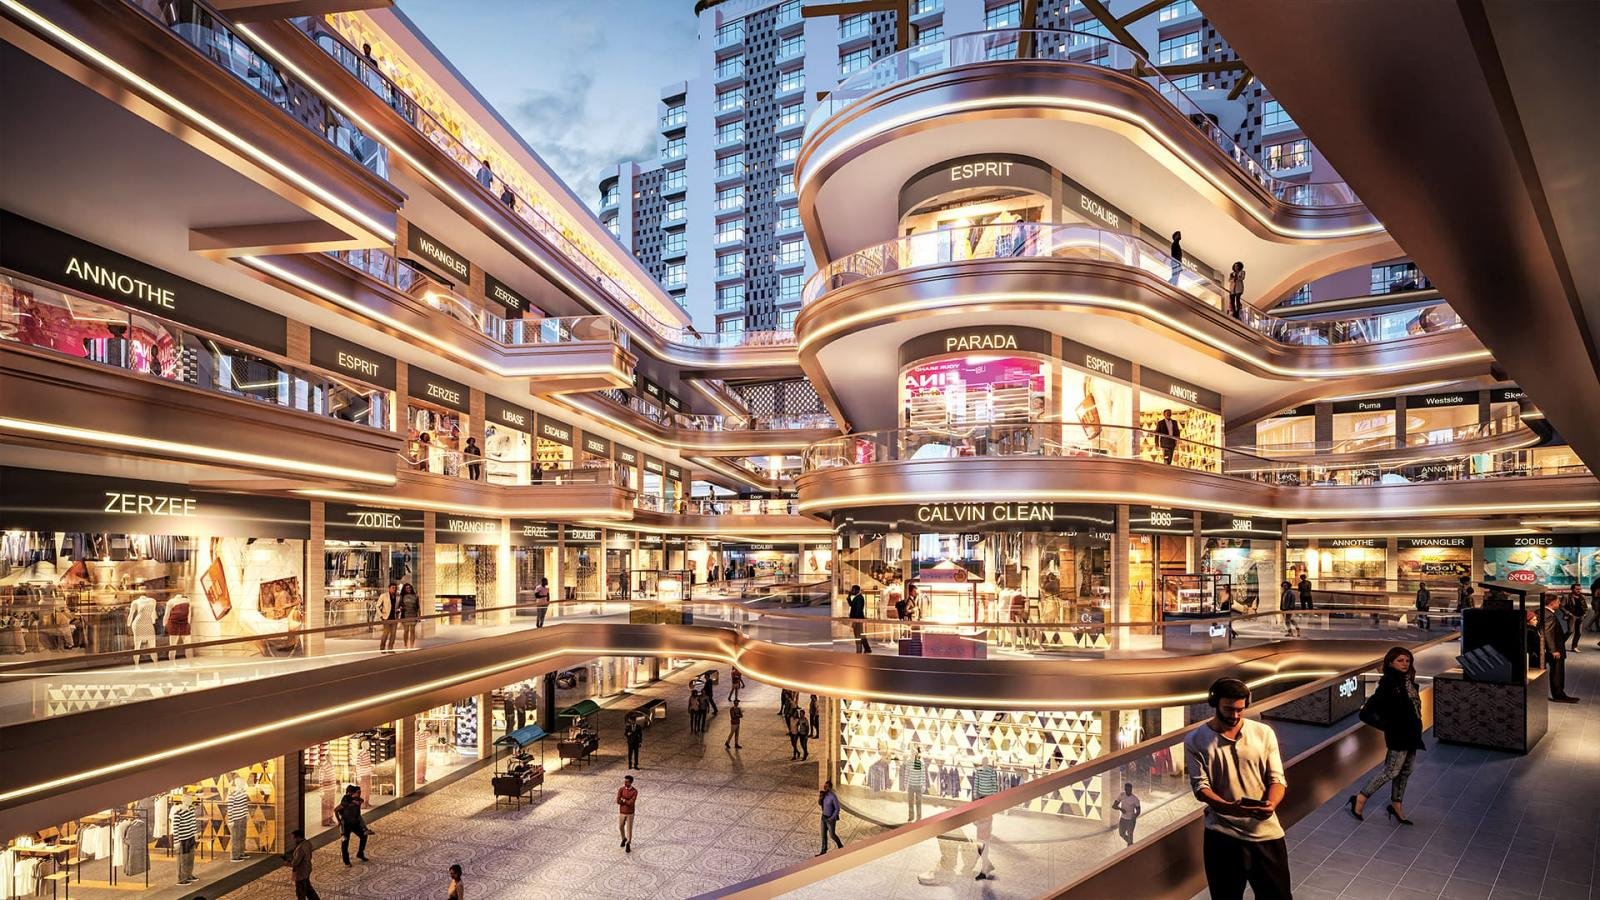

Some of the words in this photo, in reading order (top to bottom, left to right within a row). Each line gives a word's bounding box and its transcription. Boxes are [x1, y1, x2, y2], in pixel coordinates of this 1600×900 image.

[951, 162, 1013, 181] ESPRIT
[1081, 195, 1118, 229] EXCALIBR
[420, 237, 467, 278] WRANGLER
[66, 257, 175, 309] ANNOTHE
[494, 286, 519, 309] ZERZEE
[947, 335, 1017, 353] PARADA
[338, 352, 379, 378] ESPRIT
[1086, 355, 1114, 375] ESPRIT
[427, 384, 460, 405] ZERZEE
[1169, 385, 1197, 403] ANNOTHE
[1426, 395, 1463, 405] Westside
[1359, 402, 1381, 411] Puma
[502, 410, 524, 426] LIBASE
[544, 425, 569, 441] EXCALIBR
[588, 439, 604, 453] ZERZEE
[105, 493, 197, 516] ZERZEE
[917, 507, 985, 521] CALVIN
[993, 505, 1055, 520] CLEAN
[356, 512, 402, 530] ZODIEC
[448, 520, 497, 535] WRANGLER
[1151, 512, 1171, 526] BOSS
[523, 525, 548, 538] ZERZEE
[1411, 538, 1465, 546] WRANGLER
[1515, 538, 1552, 546] ZODIEC
